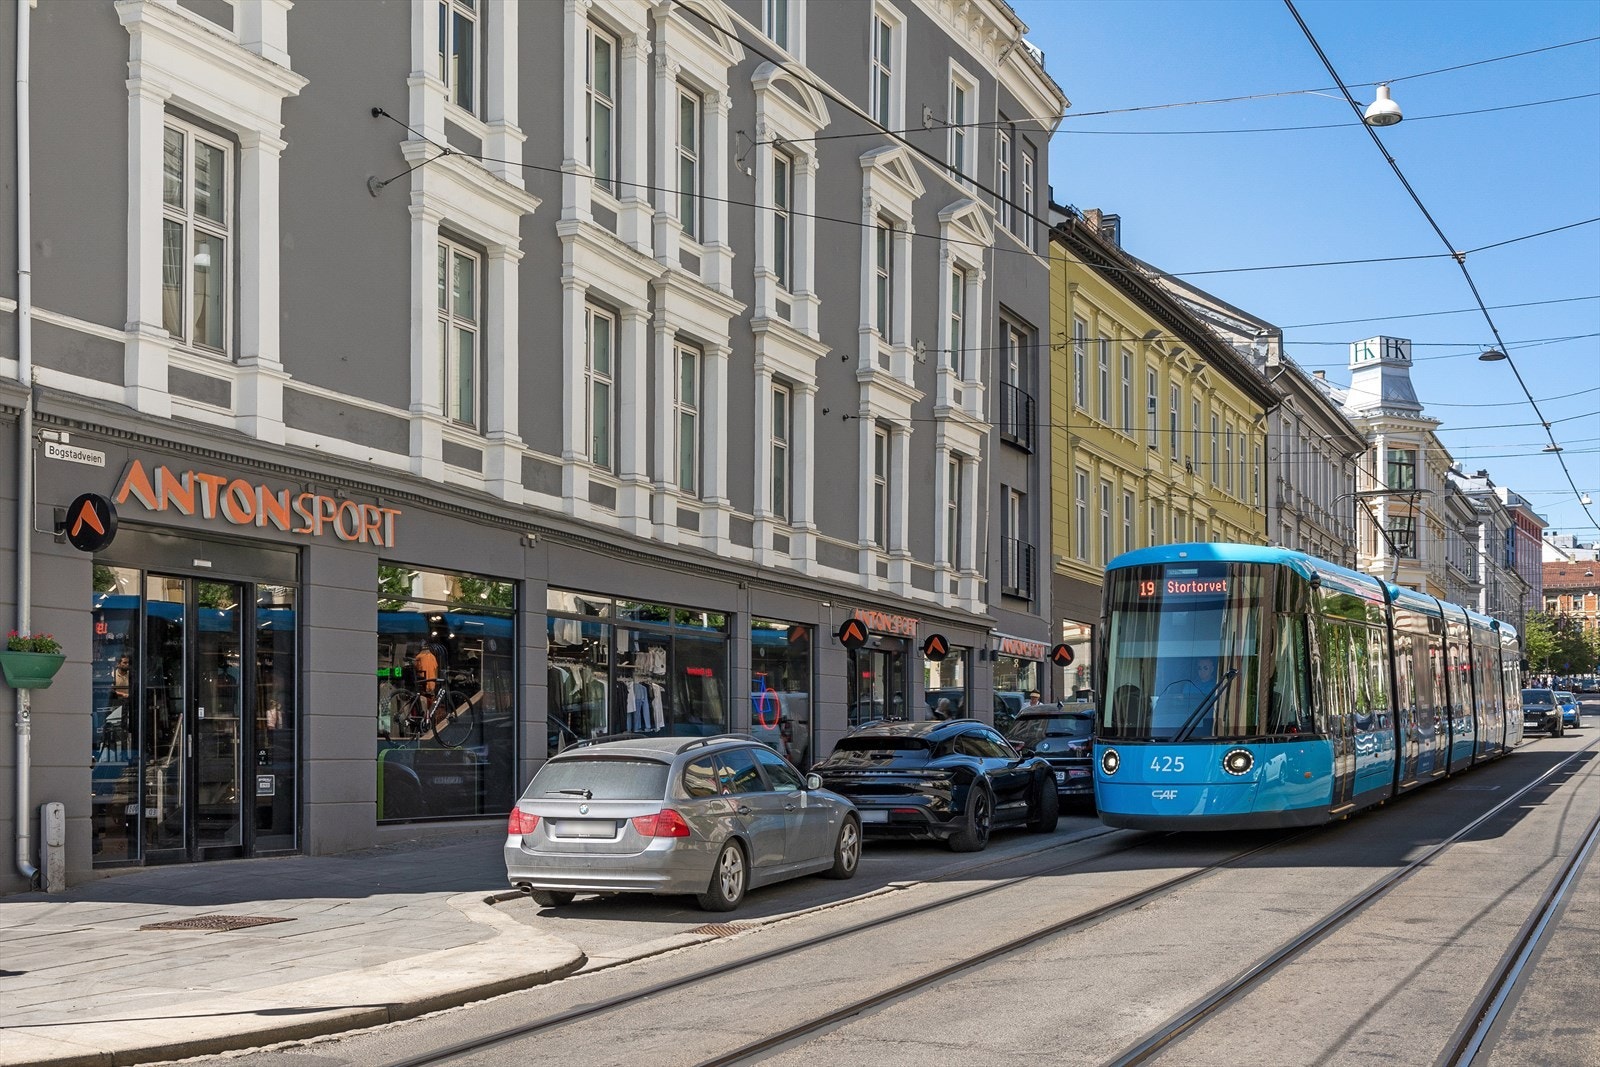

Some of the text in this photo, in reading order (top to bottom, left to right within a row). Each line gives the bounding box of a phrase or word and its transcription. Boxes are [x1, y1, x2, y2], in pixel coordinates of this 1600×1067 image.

[1354, 339, 1375, 362] HK
[1385, 338, 1407, 360] HK
[49, 445, 102, 463] Bogstadveien
[111, 459, 402, 548] ANTONSPORT
[1140, 579, 1227, 596] 19 Stortorvet
[1150, 756, 1185, 772] 425
[1151, 789, 1178, 800] CAF
